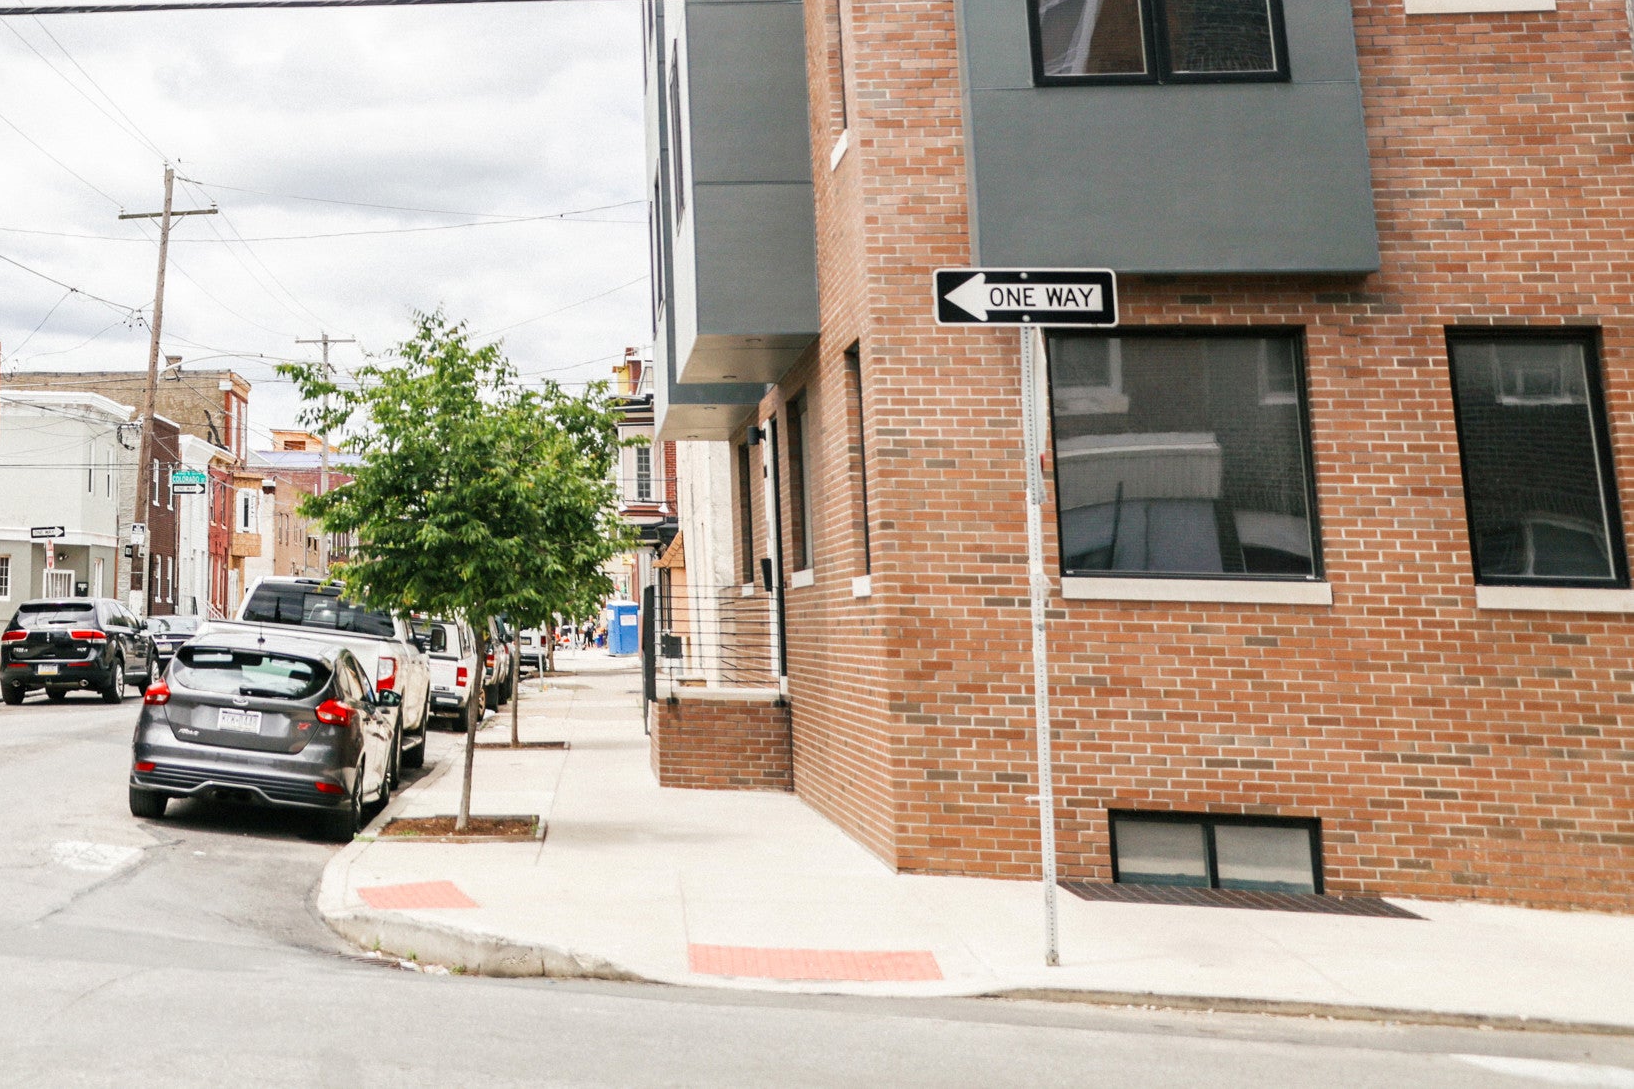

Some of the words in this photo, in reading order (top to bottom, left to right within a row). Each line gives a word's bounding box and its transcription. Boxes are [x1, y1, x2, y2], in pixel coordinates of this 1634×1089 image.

[989, 287, 1036, 307] ONE
[1045, 287, 1094, 307] WAY
[172, 475, 200, 483] COLORADO
